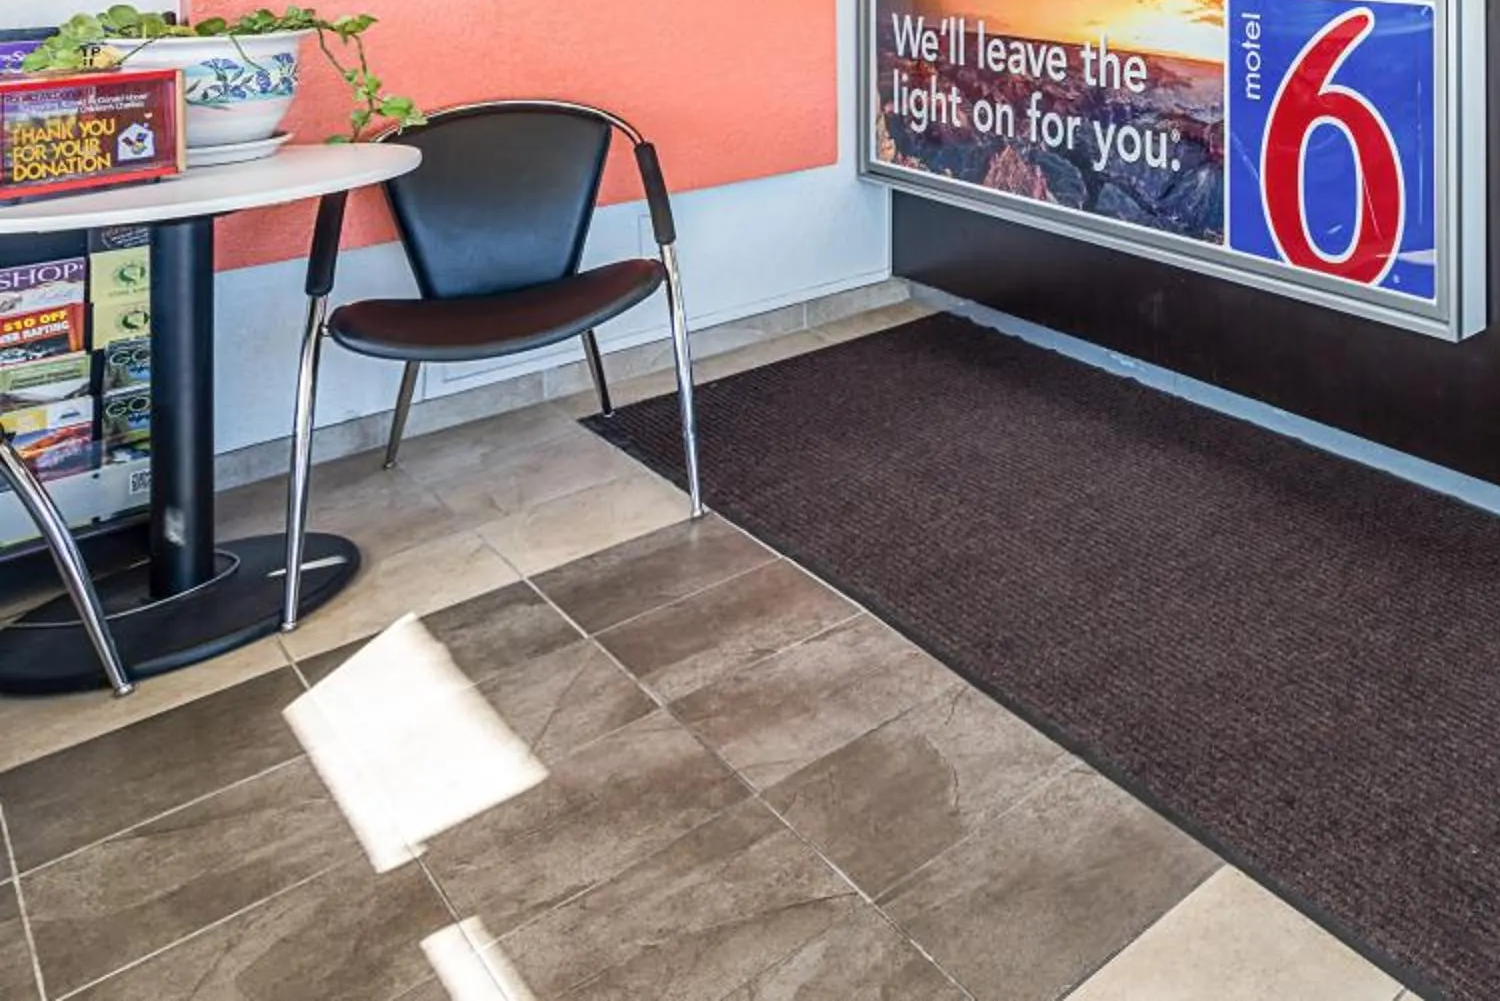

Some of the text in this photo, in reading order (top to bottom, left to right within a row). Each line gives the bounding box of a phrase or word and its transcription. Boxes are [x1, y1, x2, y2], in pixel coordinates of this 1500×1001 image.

[892, 13, 1148, 93] We'll leave the
[1243, 11, 1262, 100] motel
[12, 118, 116, 146] THANK YOU
[892, 68, 962, 133] light
[972, 98, 1014, 138] on
[1026, 90, 1081, 149] for
[13, 137, 102, 163] FOR YOUR
[13, 152, 112, 182] DONATION
[1259, 6, 1406, 288] 6
[40, 310, 68, 325] OFF
